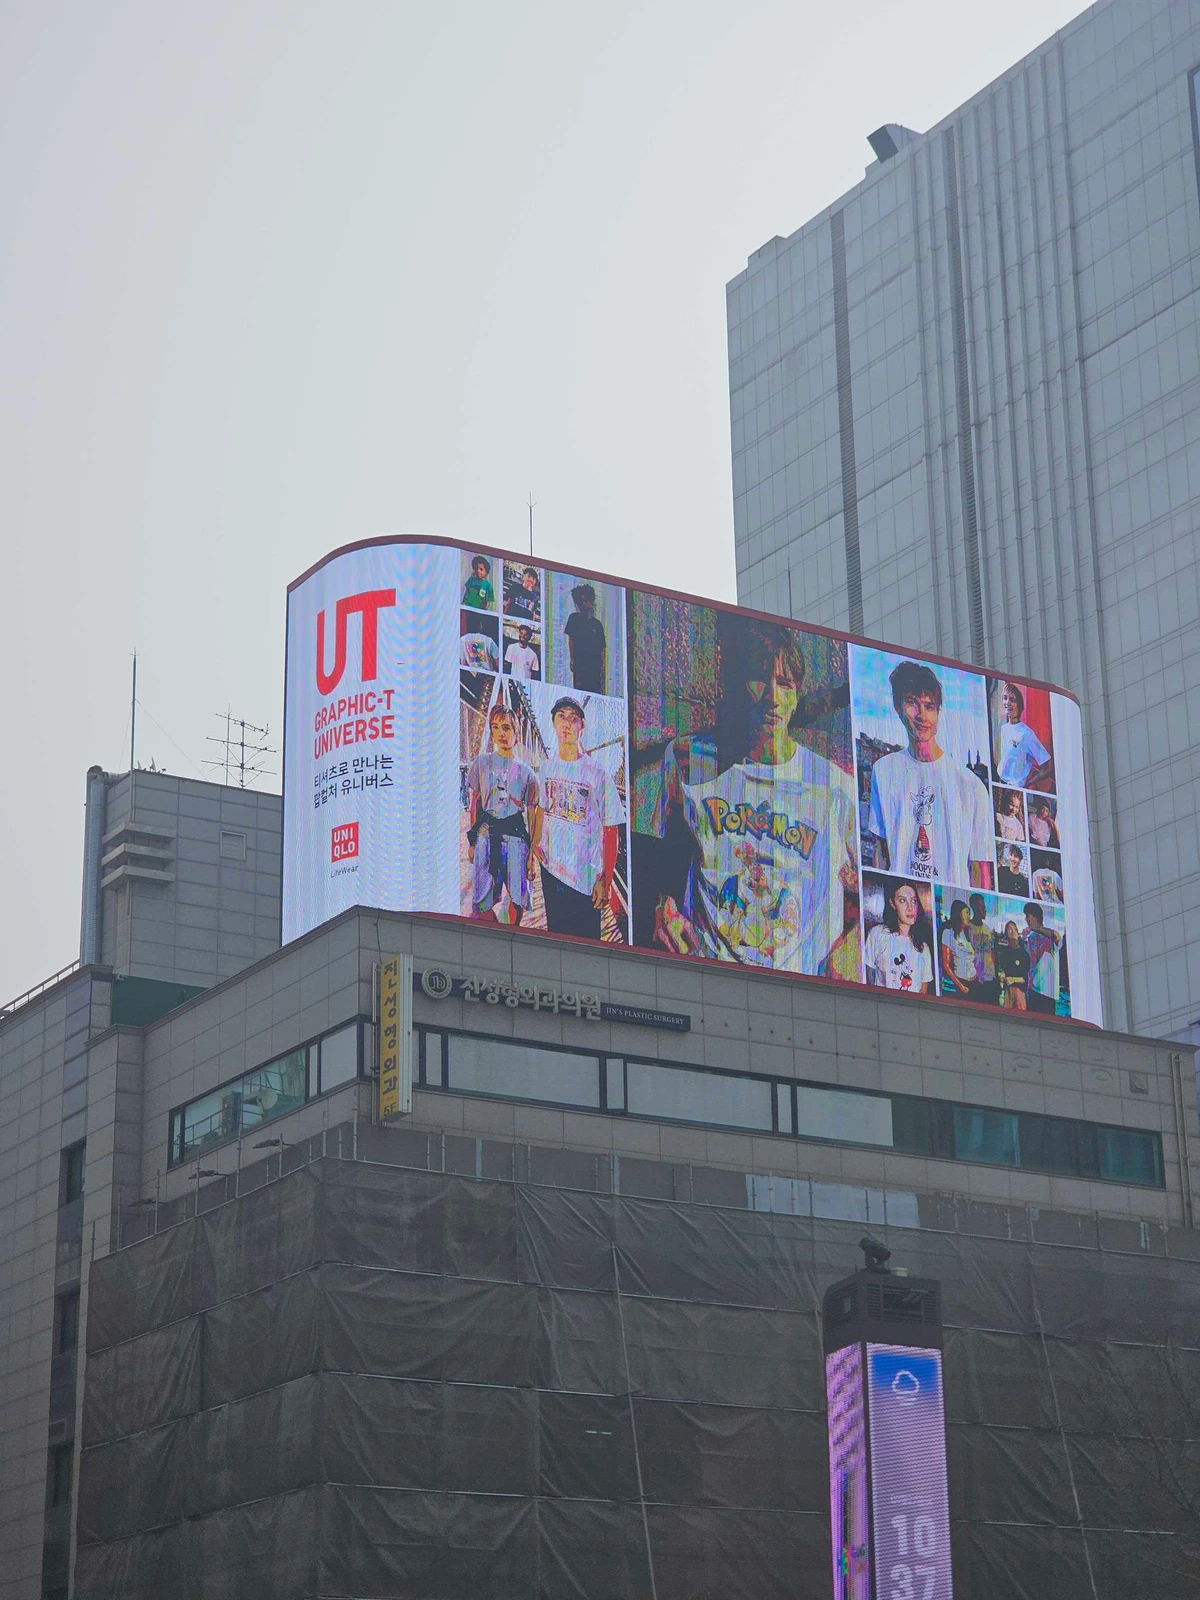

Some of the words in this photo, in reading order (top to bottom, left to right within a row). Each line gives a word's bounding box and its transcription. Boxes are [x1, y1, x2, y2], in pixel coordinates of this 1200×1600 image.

[316, 588, 396, 696] UT
[314, 689, 395, 733] GRAPHIC-T
[314, 715, 395, 760] UNIVERSE
[314, 761, 349, 788] 티셔츠로
[352, 754, 394, 774] 만나는
[313, 782, 338, 809] 팝컬처
[340, 773, 394, 795] 유니버스
[333, 827, 354, 843] UNI
[333, 841, 355, 859] QLO
[330, 865, 359, 878] LifeWear
[459, 974, 601, 1021] 진성형외과의원
[606, 1006, 623, 1016] JIN'S
[624, 1009, 653, 1020] PLASTIC
[653, 1014, 685, 1025] SURGERY
[383, 1101, 397, 1117] 5F
[890, 1514, 936, 1557] 10
